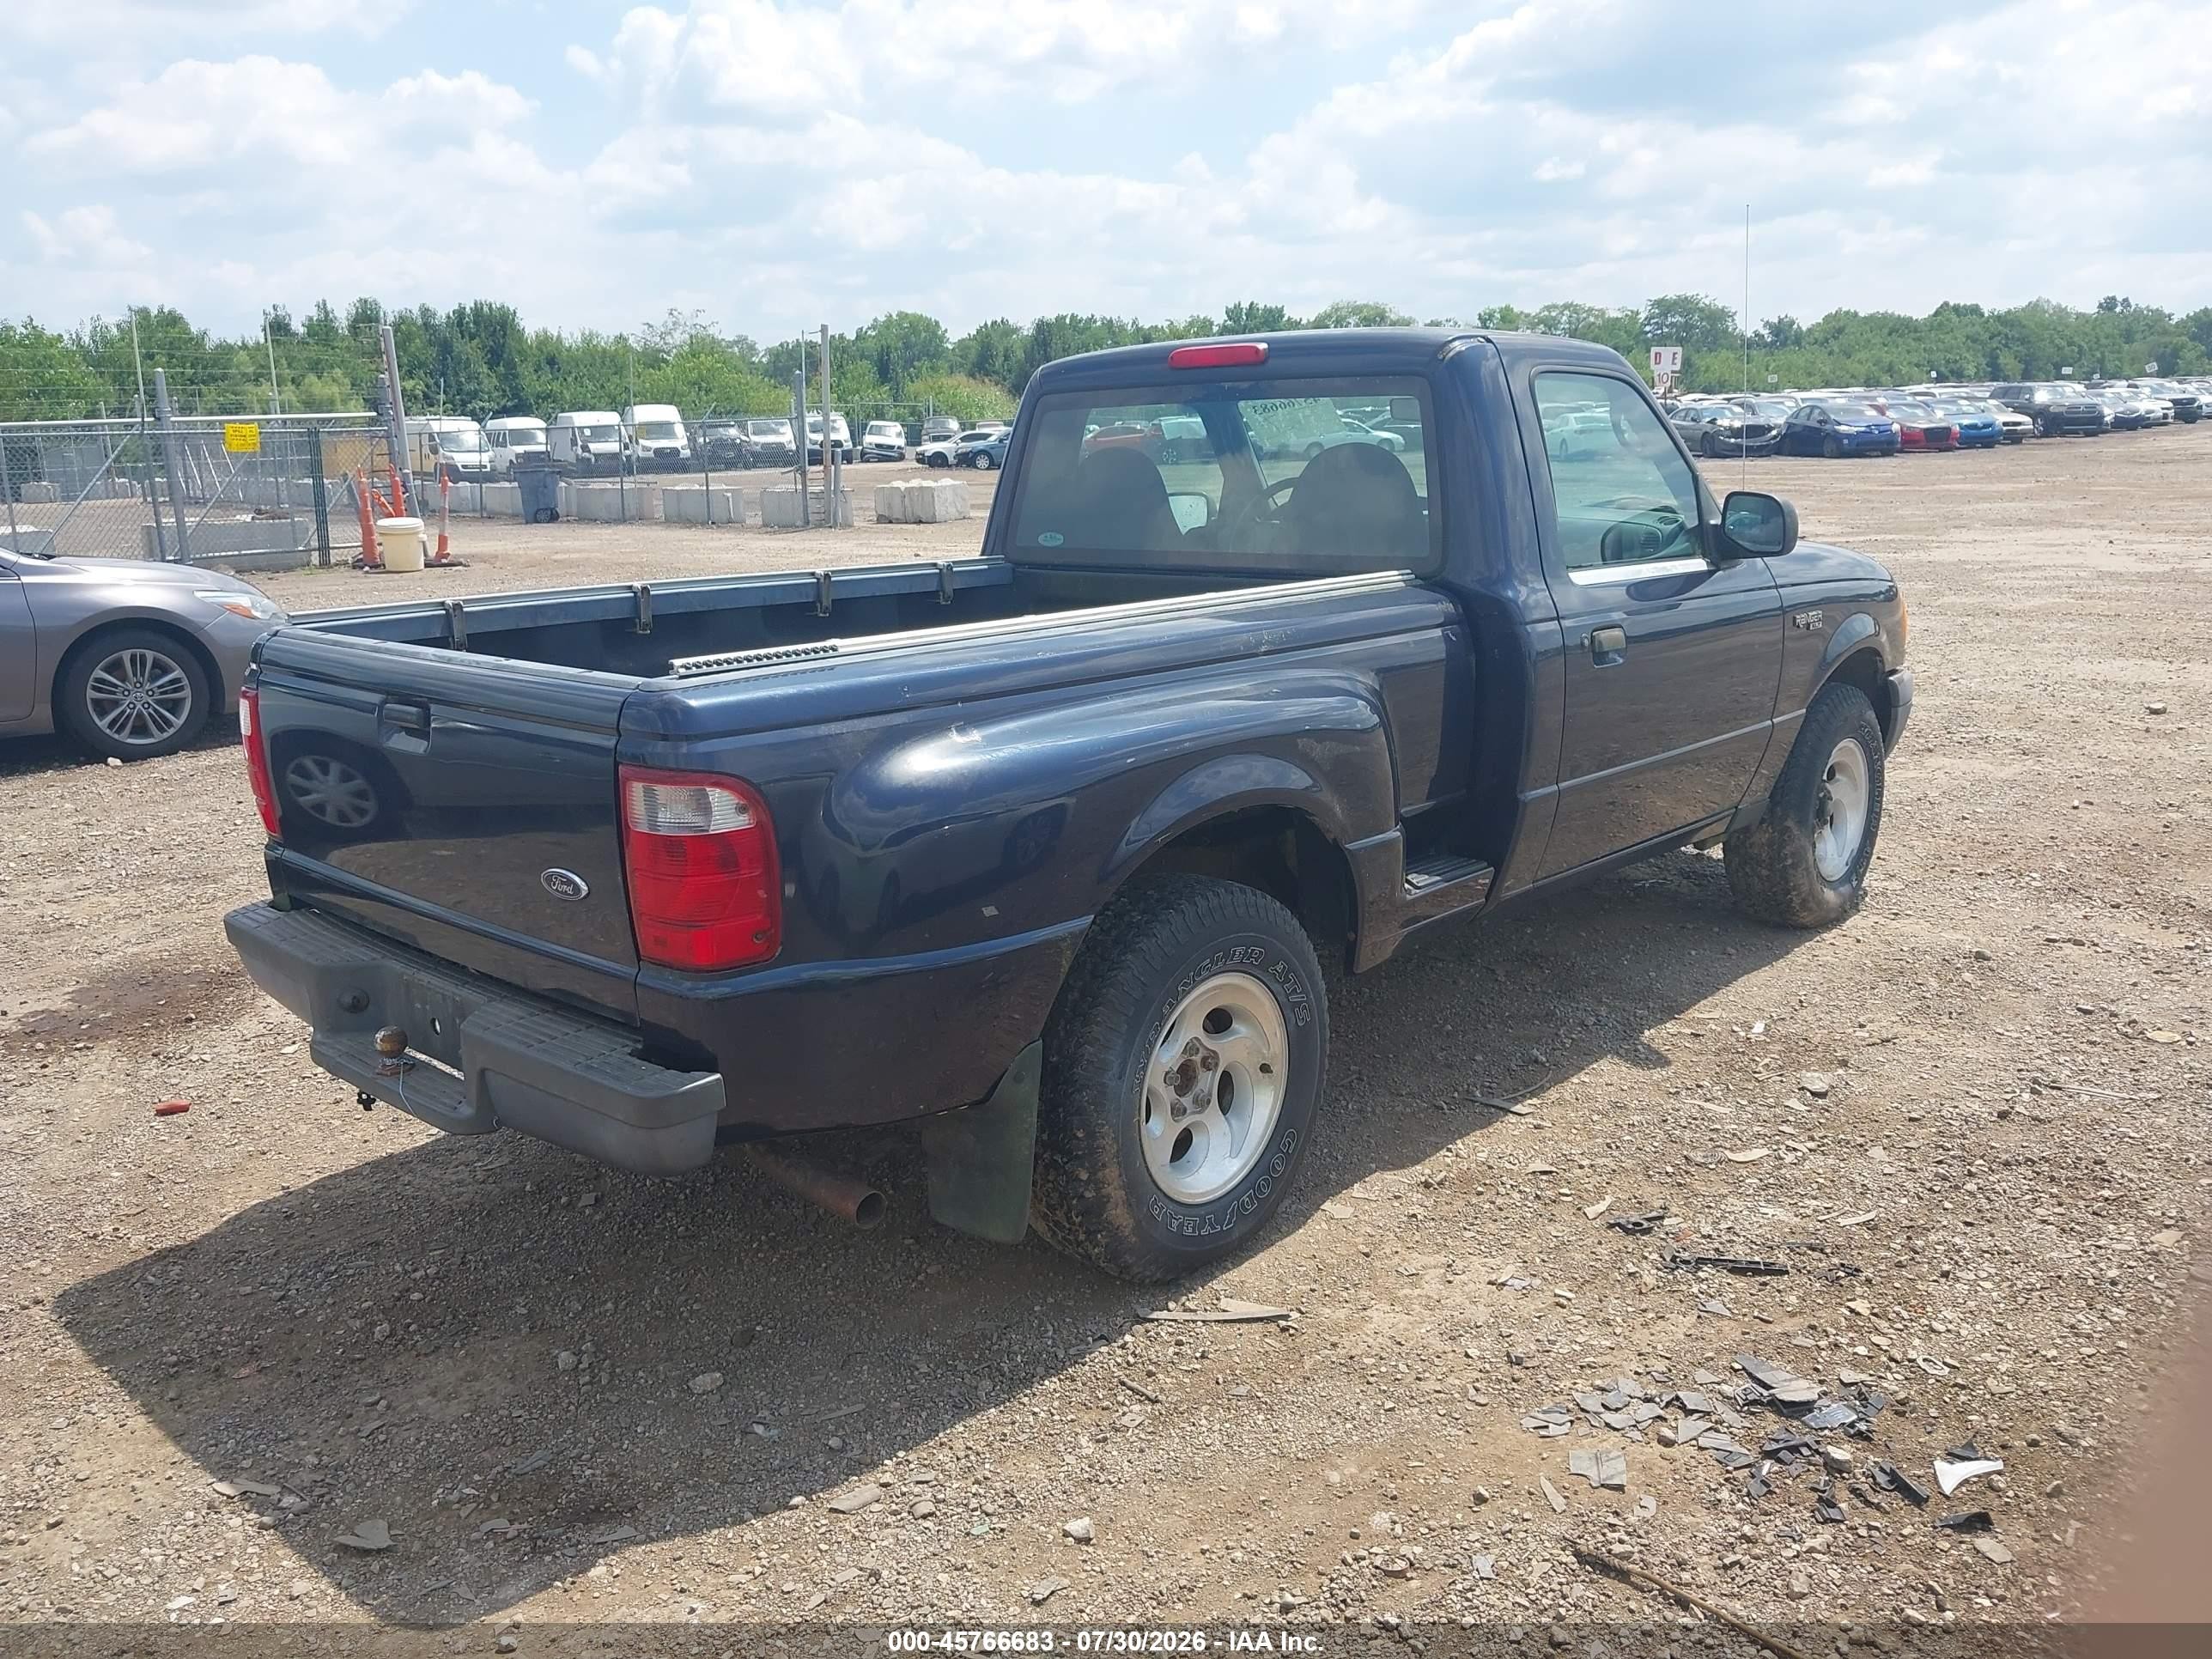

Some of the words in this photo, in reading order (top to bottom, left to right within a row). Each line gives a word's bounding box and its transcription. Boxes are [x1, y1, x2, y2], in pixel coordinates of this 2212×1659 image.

[1654, 351, 1662, 366] D
[1671, 351, 1679, 366] E
[1657, 372, 1669, 385] 10
[550, 874, 574, 895] Ford
